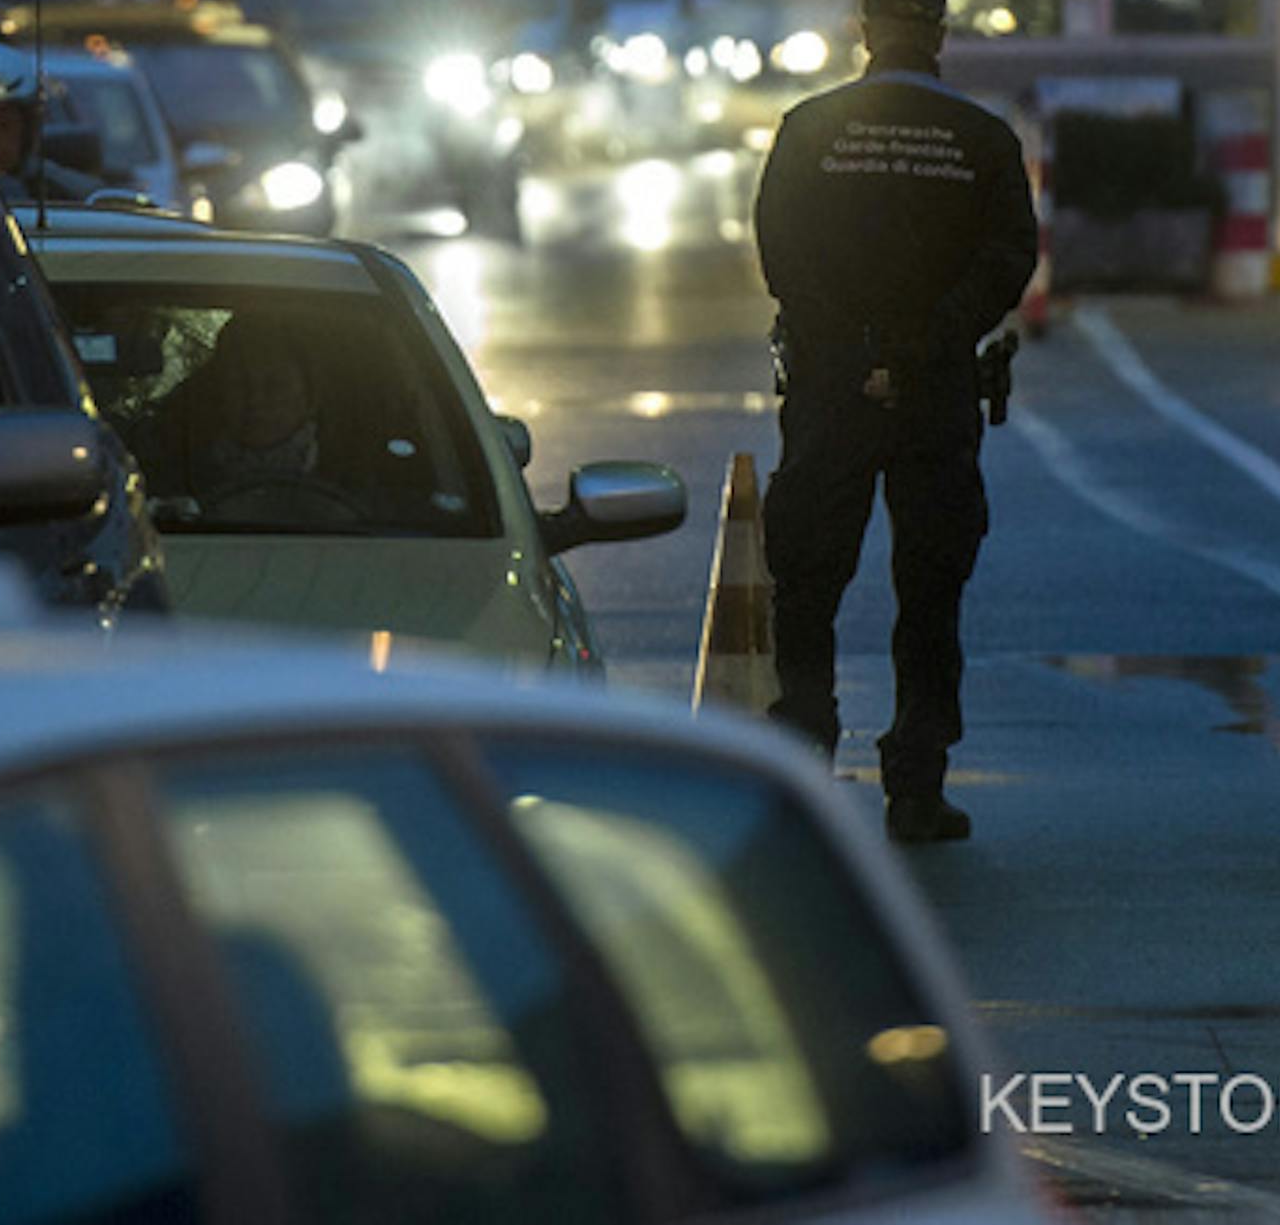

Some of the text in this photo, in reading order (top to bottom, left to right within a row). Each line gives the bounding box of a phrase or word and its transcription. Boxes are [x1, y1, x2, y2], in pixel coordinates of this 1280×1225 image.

[845, 121, 955, 143] Grenzwache
[822, 154, 977, 182] Guardia di confine
